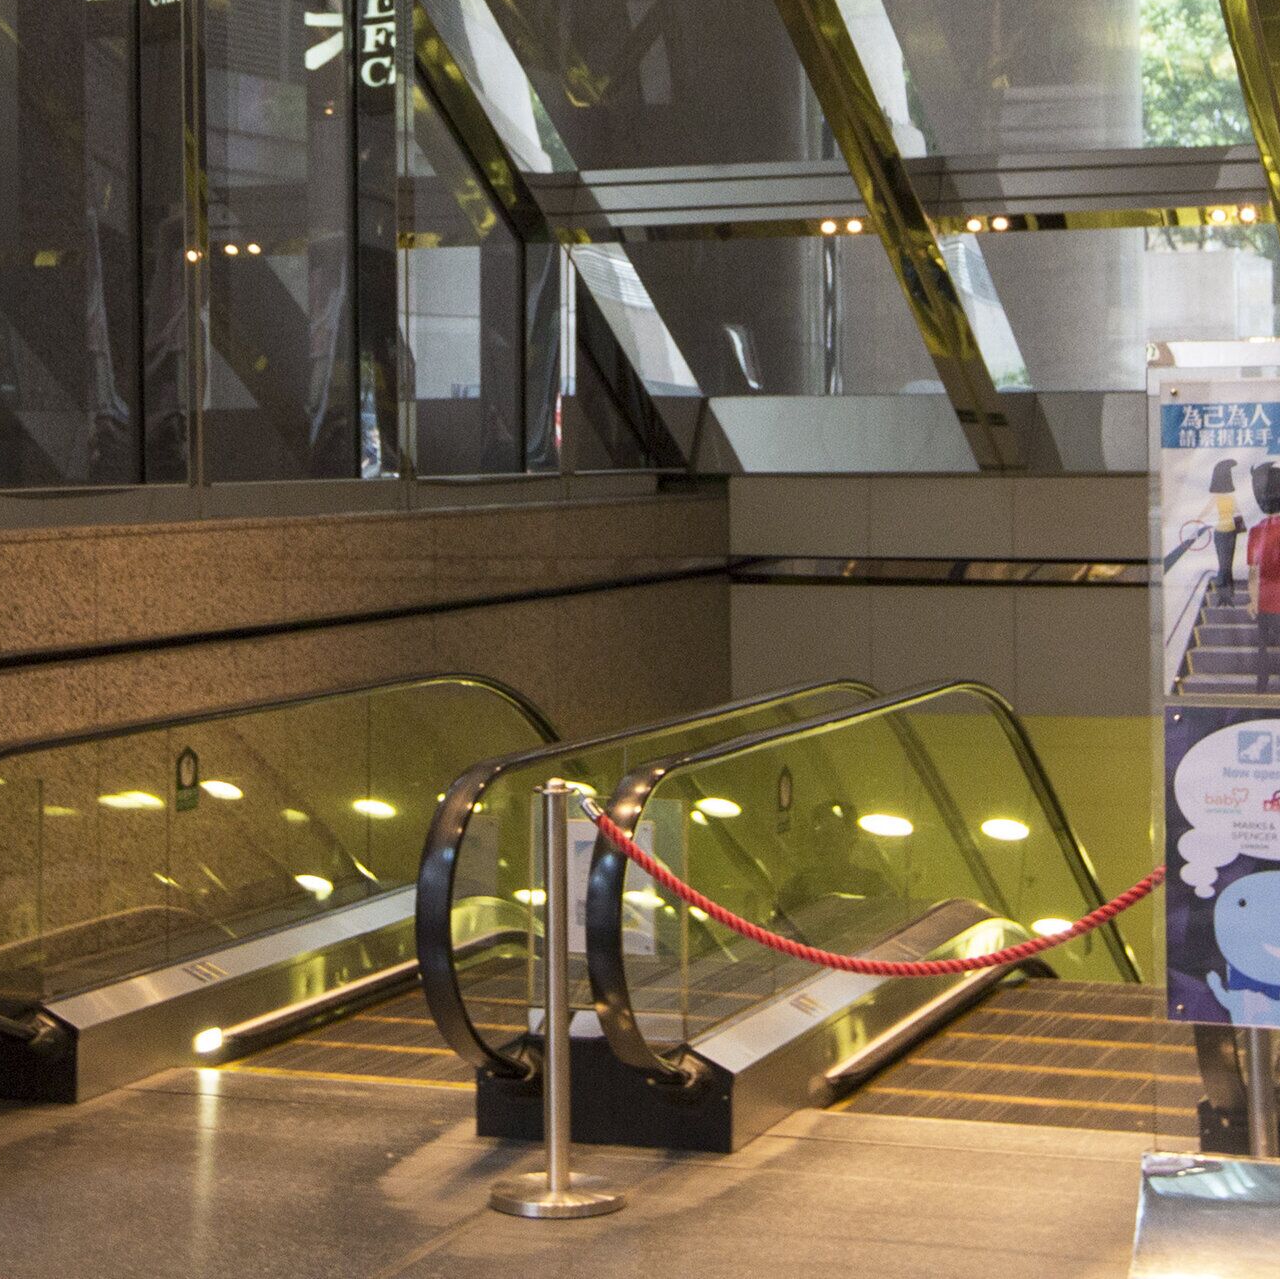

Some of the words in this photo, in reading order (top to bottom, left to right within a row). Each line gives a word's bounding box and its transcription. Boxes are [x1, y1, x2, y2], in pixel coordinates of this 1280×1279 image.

[1179, 404, 1272, 429] 為己為人
[1179, 428, 1272, 448] 請緊握扶手
[1222, 767, 1250, 778] Now
[1205, 793, 1241, 808] baby
[1233, 821, 1267, 830] MARKS
[1231, 831, 1278, 841] SPENCER
